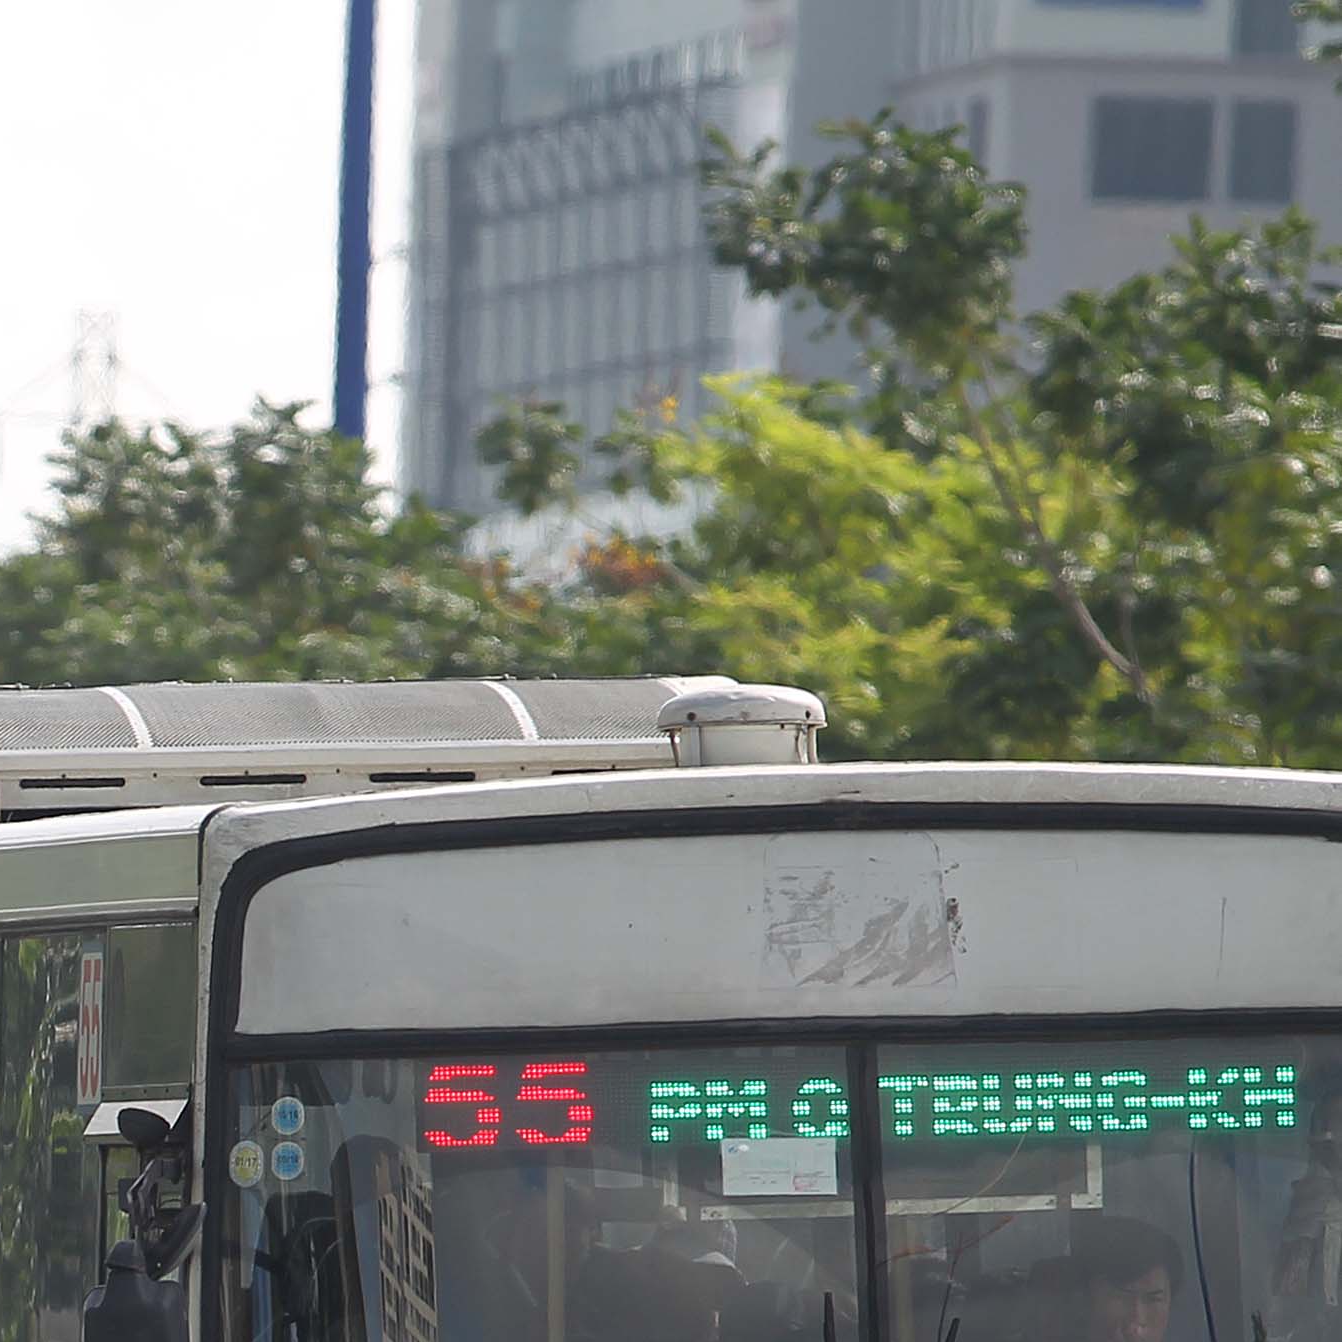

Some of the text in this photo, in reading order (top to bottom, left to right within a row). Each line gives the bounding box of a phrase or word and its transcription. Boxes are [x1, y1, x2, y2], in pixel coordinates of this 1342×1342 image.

[79, 959, 101, 1098] 55
[424, 1062, 596, 1148] 55
[648, 1078, 768, 1144] PM
